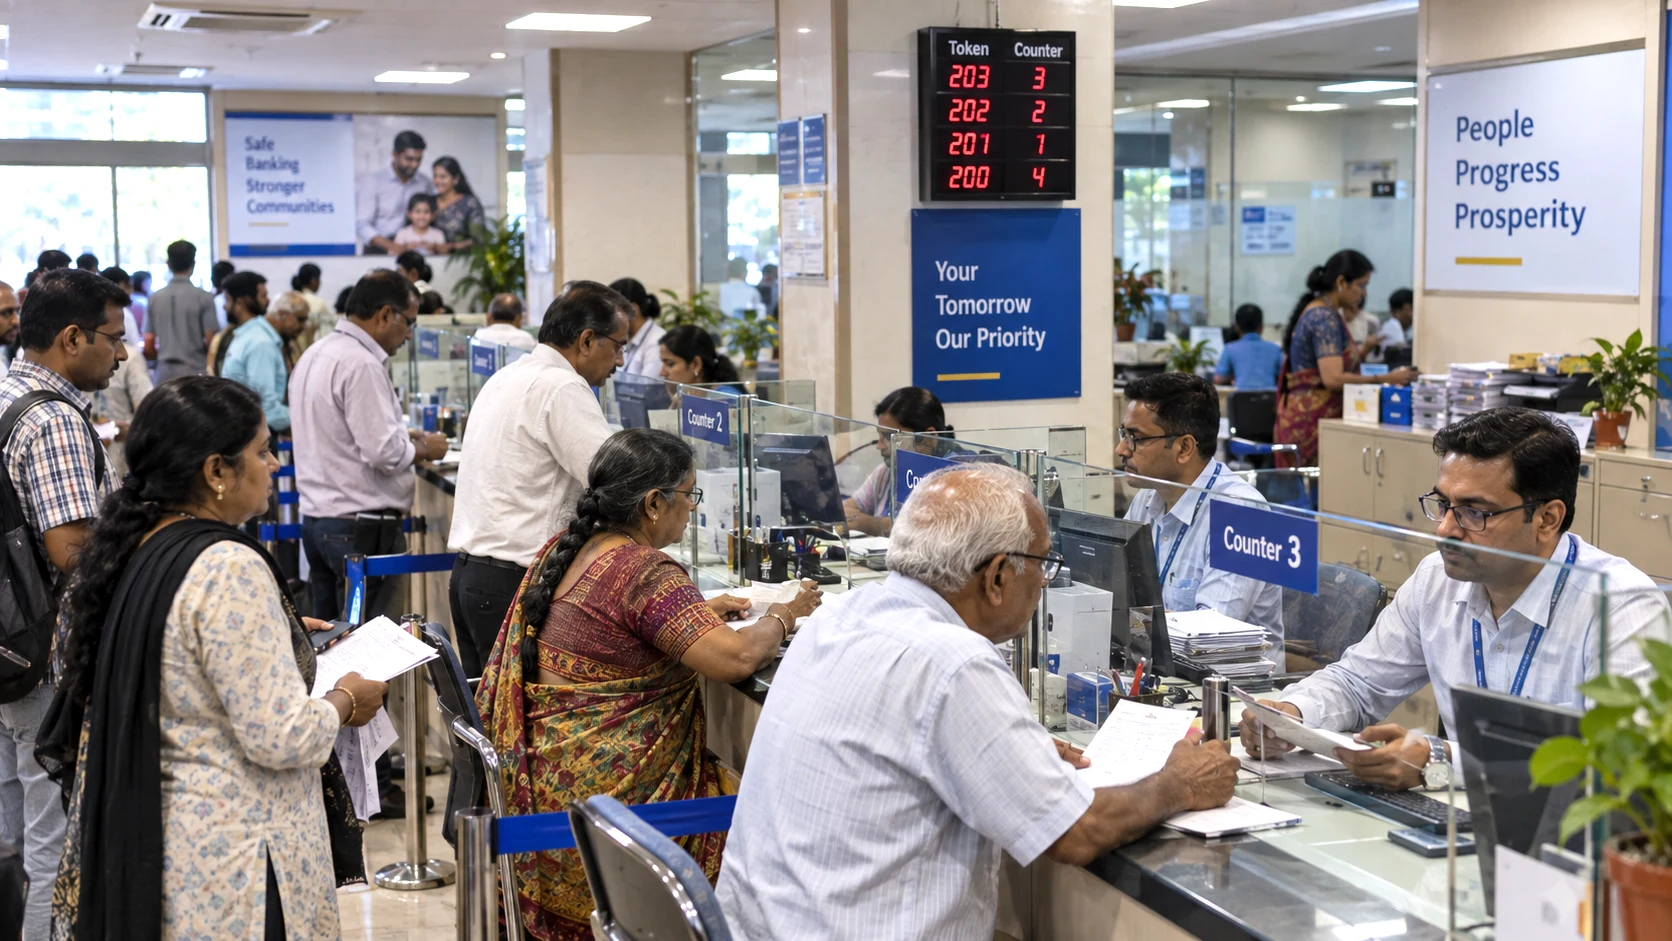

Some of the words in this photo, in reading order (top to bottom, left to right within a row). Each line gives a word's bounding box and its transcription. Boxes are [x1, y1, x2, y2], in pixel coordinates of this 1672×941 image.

[948, 40, 990, 56] Token
[1014, 41, 1064, 58] Counter
[948, 65, 991, 89] 203
[1032, 66, 1047, 90] 3
[948, 98, 991, 123] 202
[1031, 100, 1046, 123] 2
[1456, 109, 1534, 147] People
[244, 135, 276, 152] Safe
[948, 132, 990, 156] 201
[1036, 133, 1046, 155] 1
[245, 155, 300, 174] Banking
[1456, 159, 1560, 193] Progress
[245, 177, 305, 197] Stronger
[948, 165, 991, 189] 200
[1032, 167, 1046, 189] 4
[246, 197, 335, 215] Communities
[1455, 199, 1587, 237] Prosperity
[935, 260, 979, 282] Your
[935, 294, 1032, 316] Tomorrow
[935, 328, 972, 350] Our
[976, 324, 1047, 352] Priority
[687, 408, 715, 430] Counter
[716, 411, 723, 433] 2
[1223, 525, 1283, 563] Counter
[1286, 534, 1303, 569] 3
